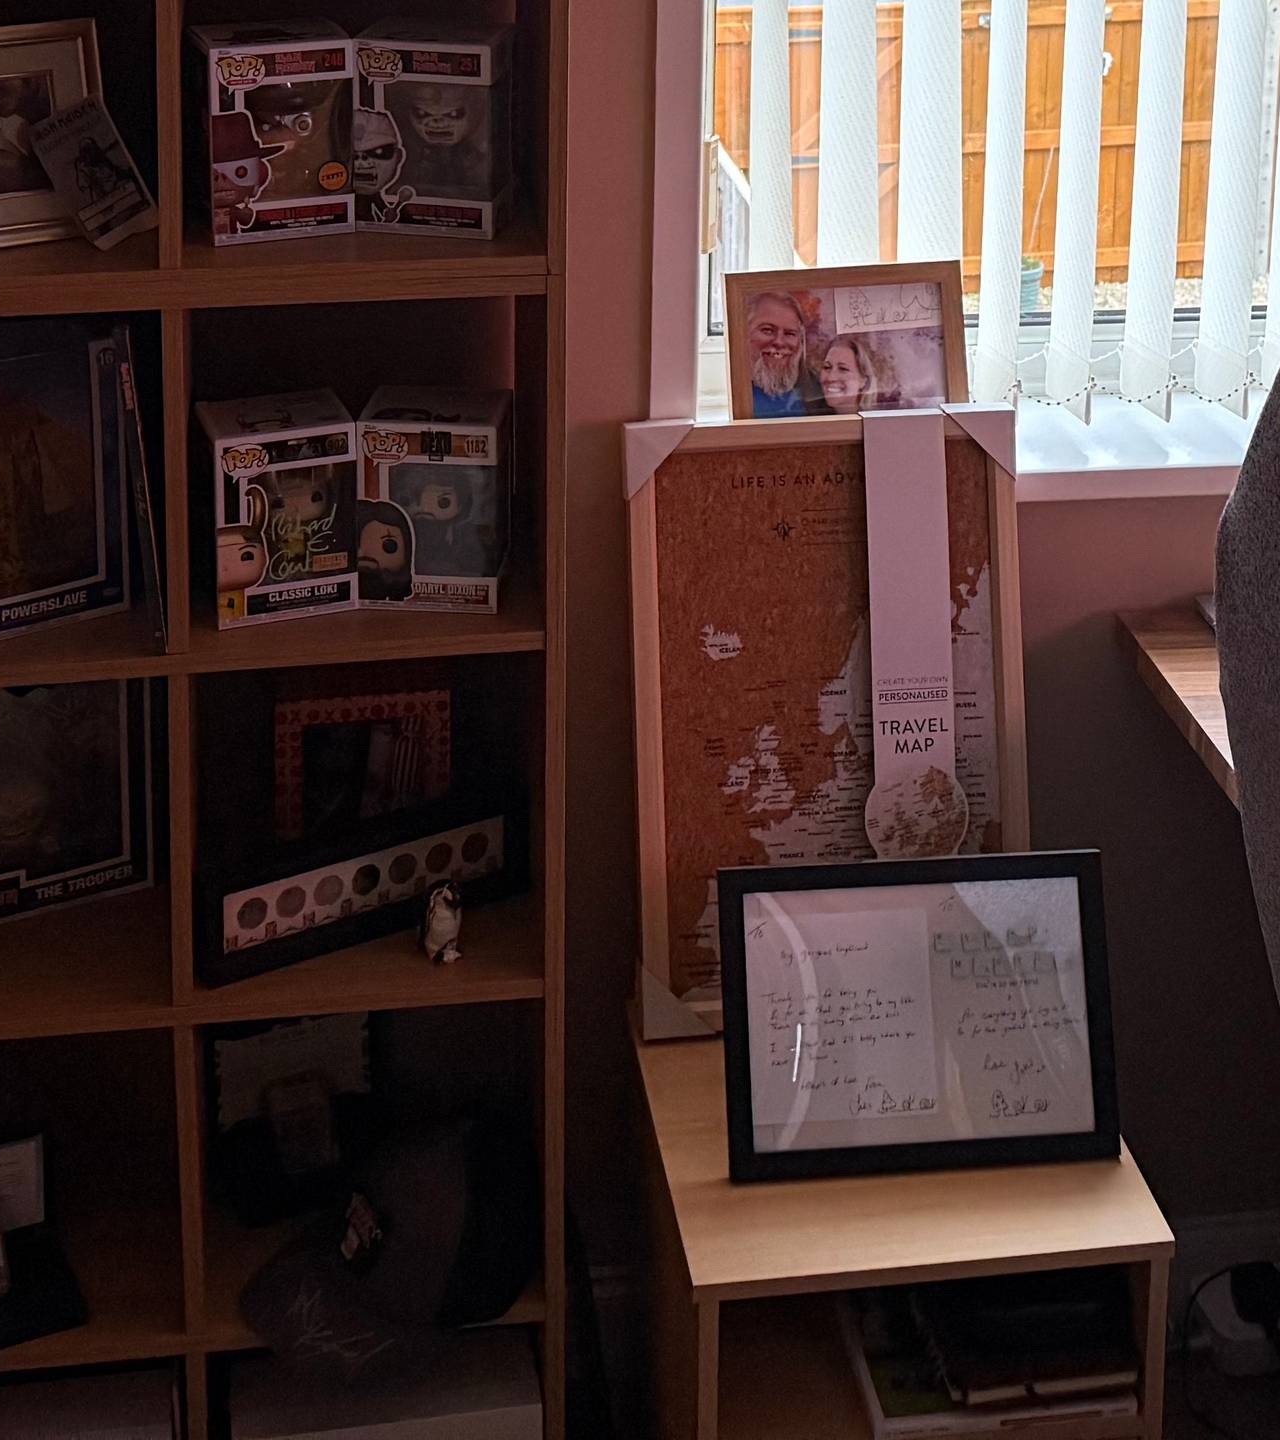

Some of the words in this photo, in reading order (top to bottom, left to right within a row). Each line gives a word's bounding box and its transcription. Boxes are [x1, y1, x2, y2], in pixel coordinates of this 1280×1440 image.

[216, 56, 263, 80] POP!
[357, 47, 401, 69] POP!
[362, 432, 407, 455] POP!
[466, 439, 487, 454] 1182
[222, 450, 267, 473] POP!
[732, 475, 766, 489] LIFE
[772, 474, 787, 487] IS
[794, 473, 816, 486] AN
[269, 588, 312, 602] CLASSIC
[314, 583, 338, 596] LOKI
[414, 582, 445, 595] DARYL
[448, 583, 476, 596] DIXON
[1, 590, 89, 622] POWERSLAVE
[878, 689, 949, 702] PERSONALISED
[879, 717, 949, 736] TRAVEL
[894, 738, 935, 755] MAP
[36, 883, 65, 900] THE
[69, 865, 133, 890] TROOPER
